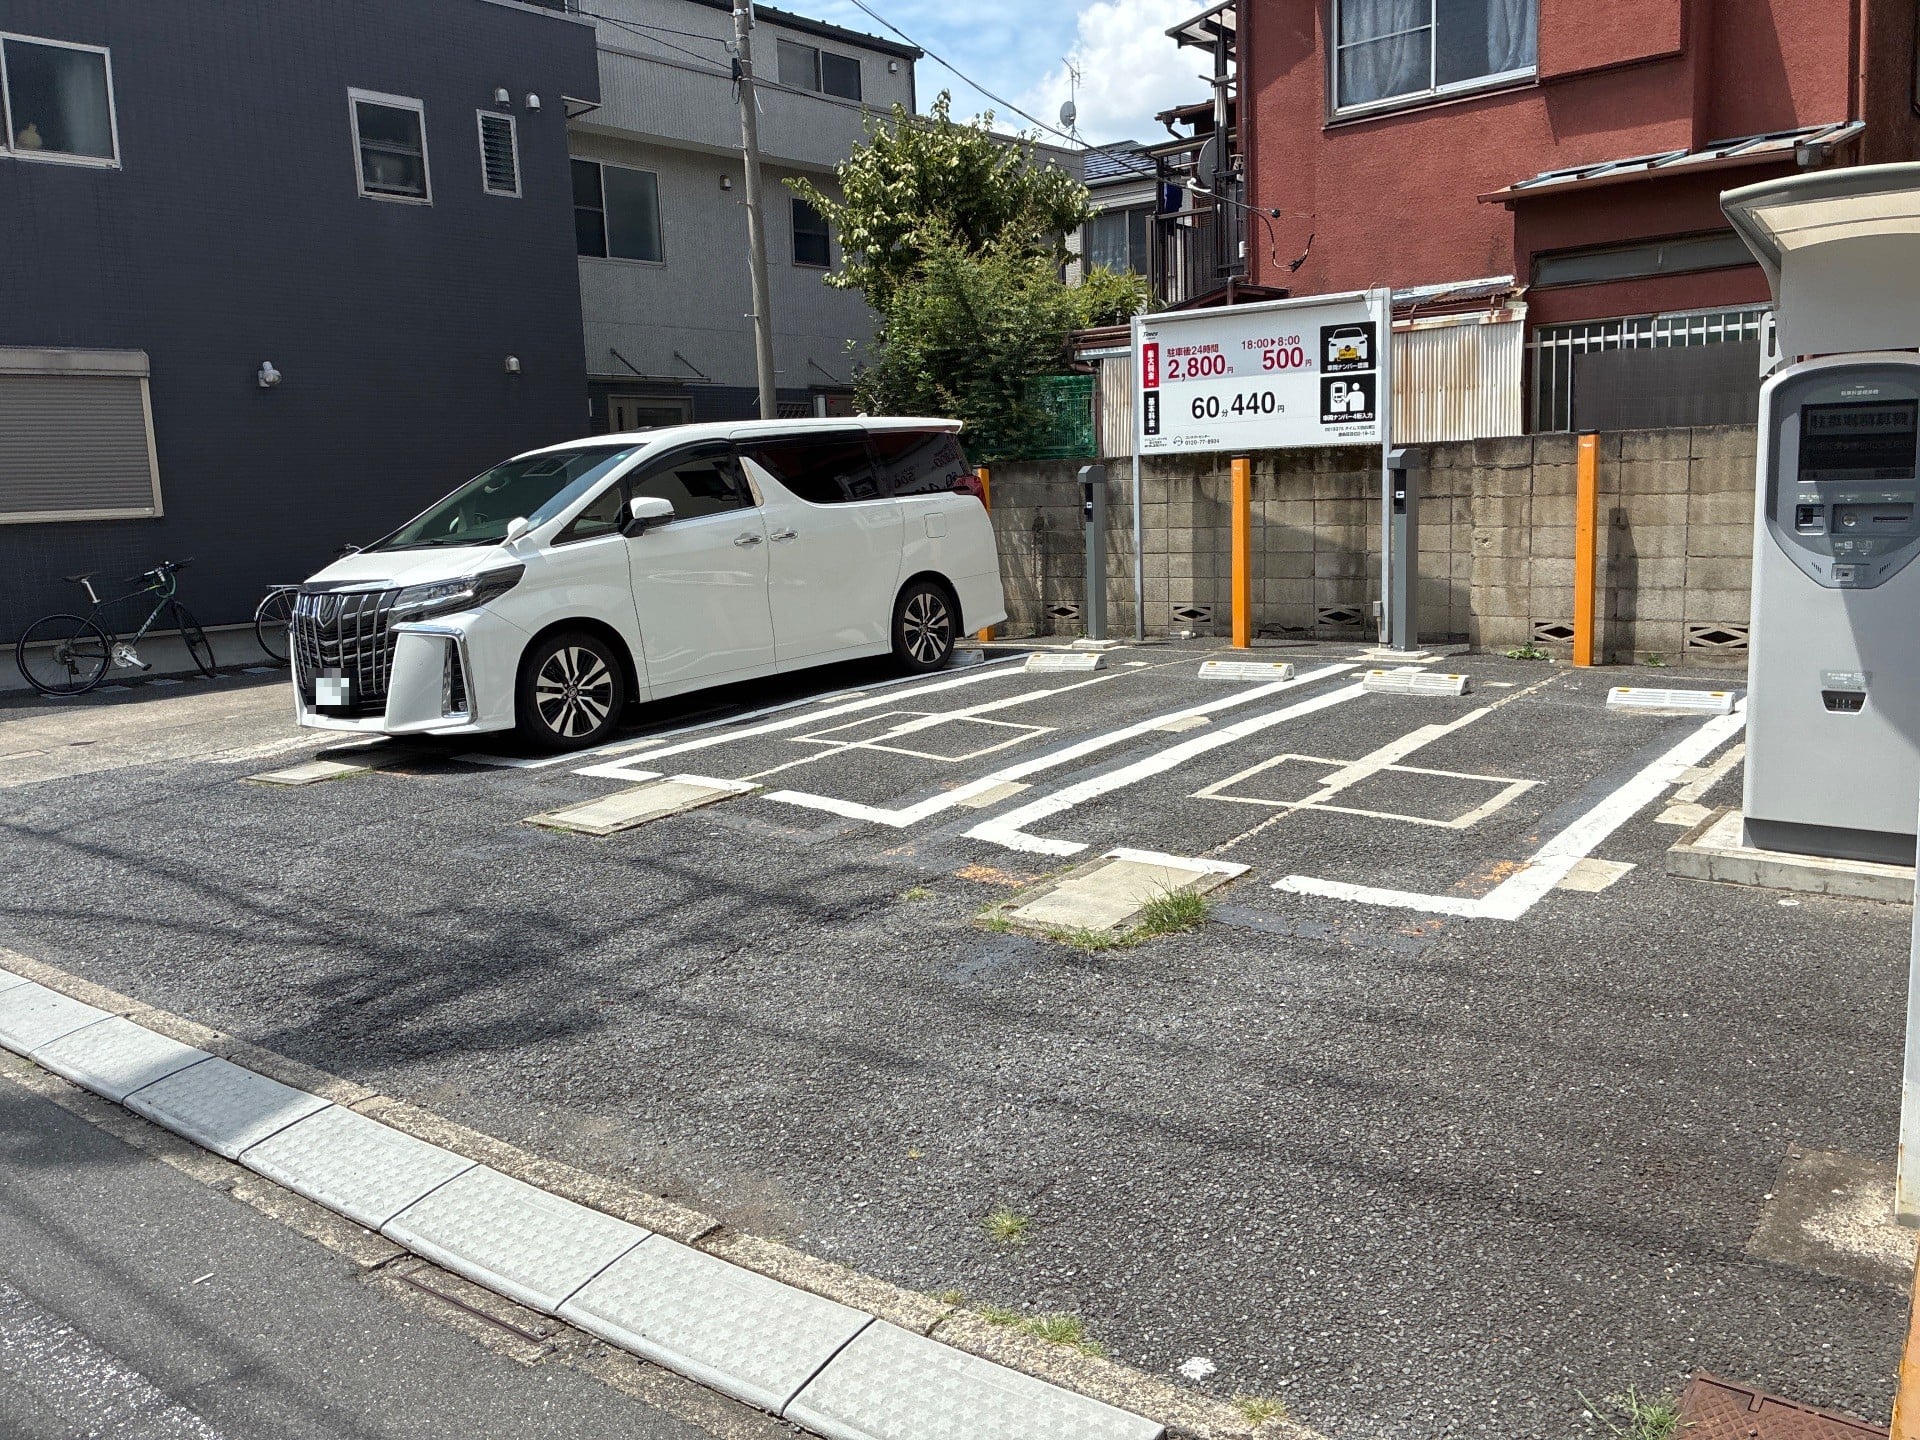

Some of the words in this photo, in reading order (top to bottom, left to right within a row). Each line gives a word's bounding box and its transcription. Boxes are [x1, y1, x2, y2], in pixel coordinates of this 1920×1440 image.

[1167, 343, 1219, 357] 駐車後24時間
[1241, 338, 1269, 350] 18:00
[1277, 335, 1300, 347] 8:00
[1167, 354, 1234, 381] 2,800円
[1262, 346, 1312, 370] 500円
